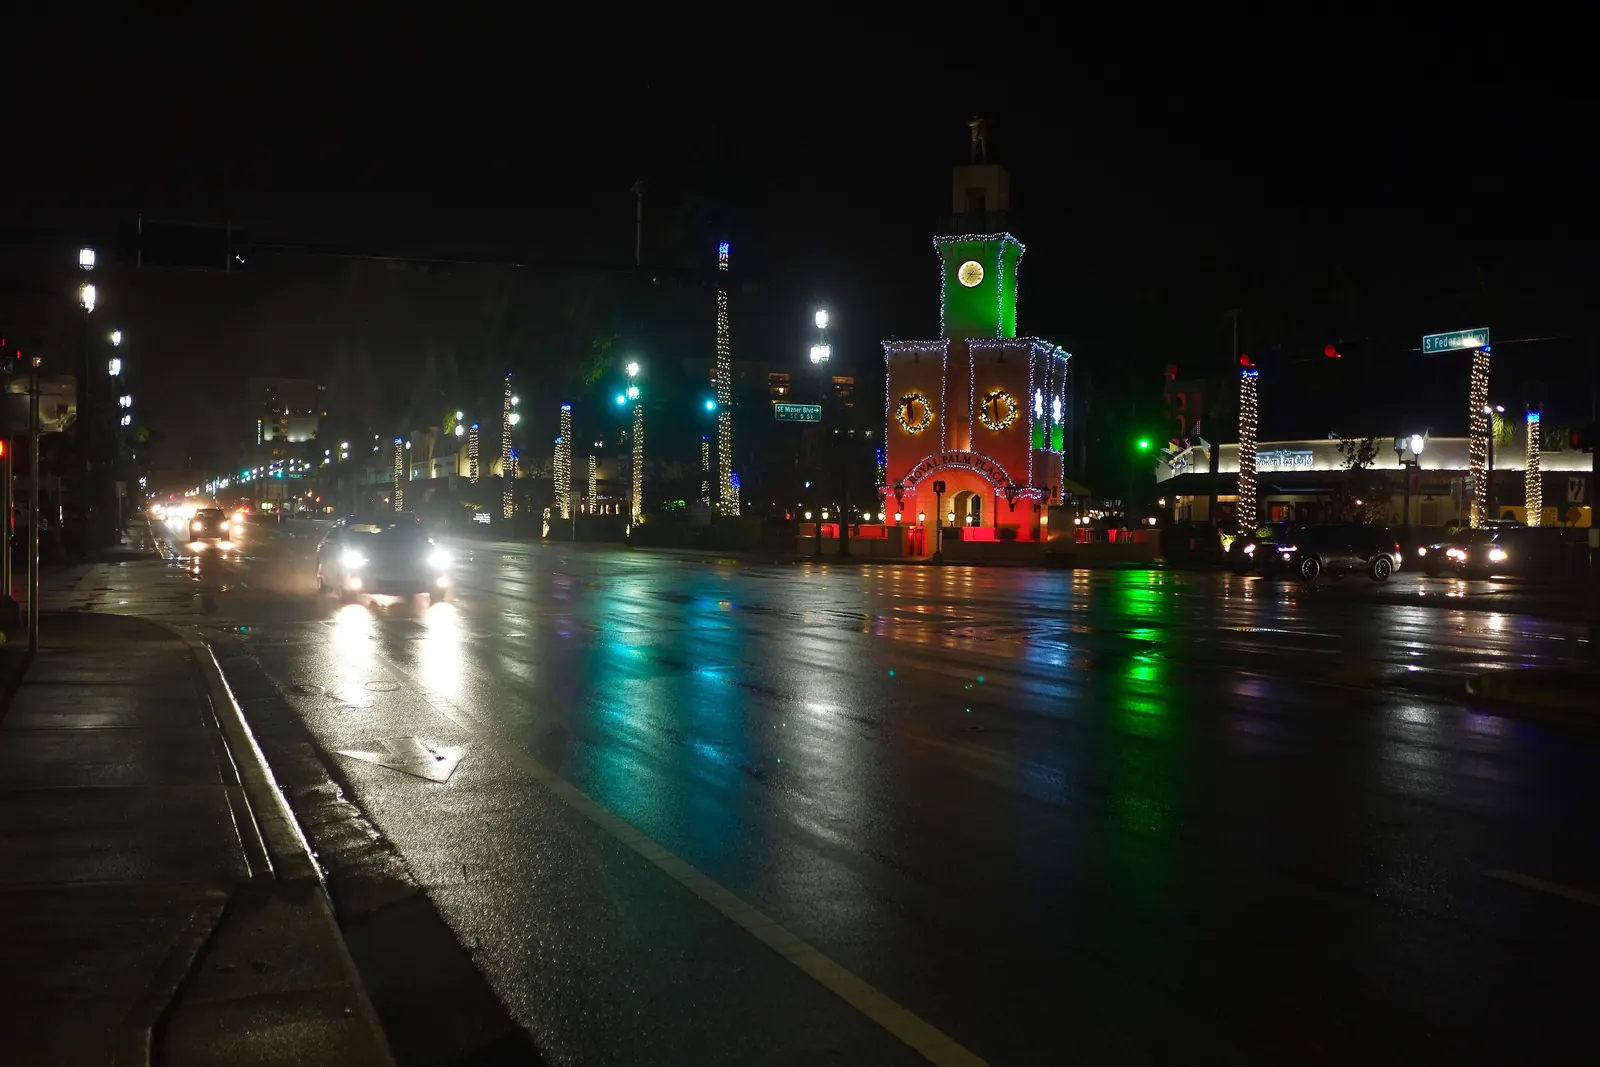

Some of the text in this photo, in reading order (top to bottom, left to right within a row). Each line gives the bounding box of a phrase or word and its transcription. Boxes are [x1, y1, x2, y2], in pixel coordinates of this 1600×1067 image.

[1426, 339, 1431, 350] S
[1434, 335, 1464, 349] Federal
[908, 454, 1006, 486] ROYAL PALM PLACE
